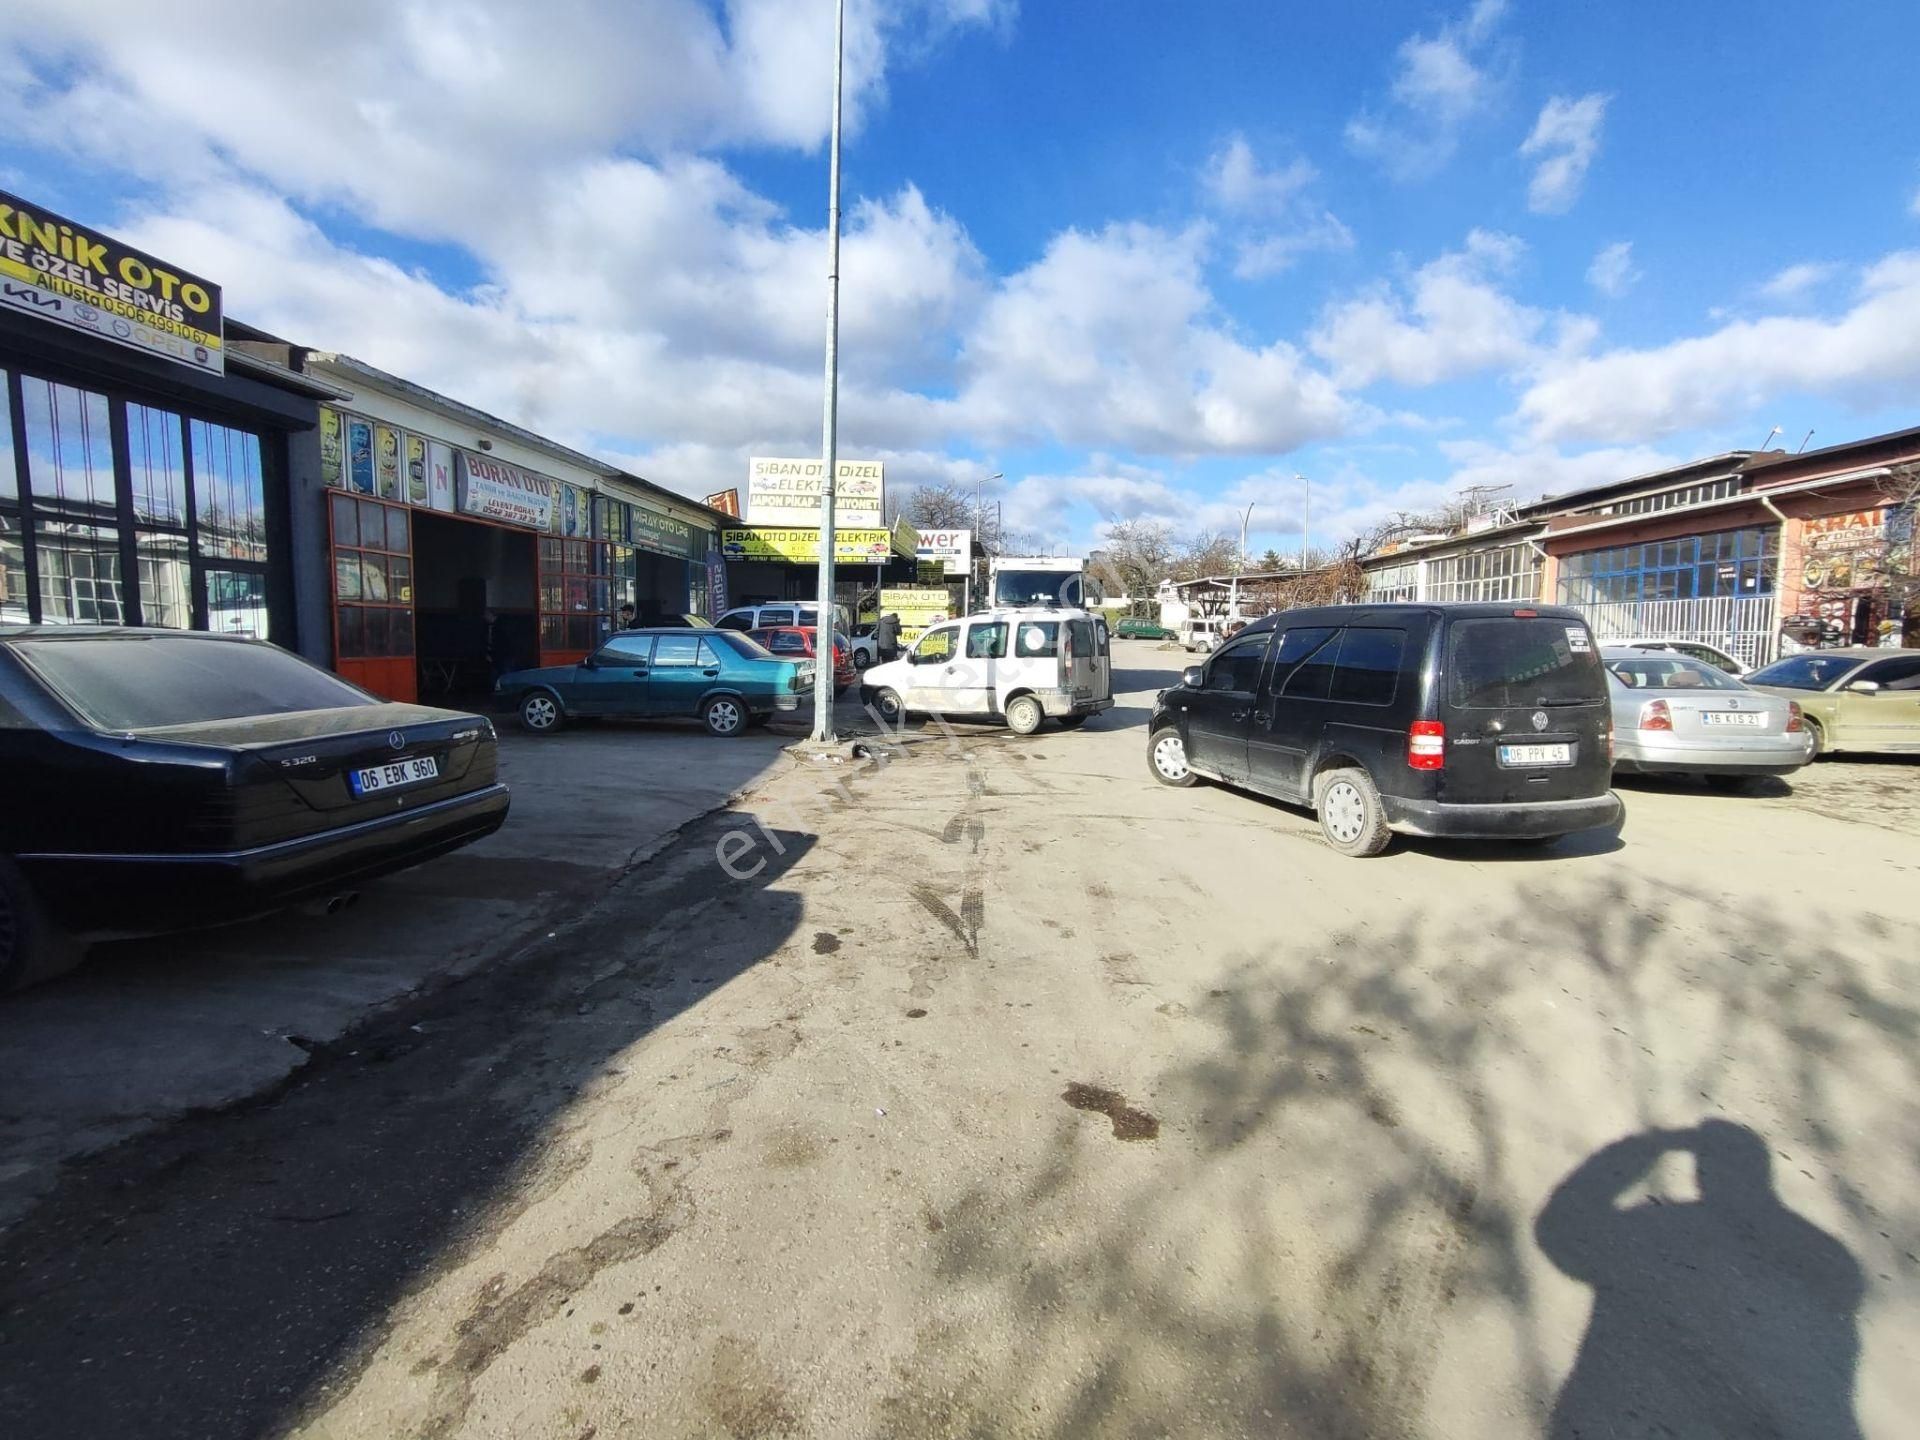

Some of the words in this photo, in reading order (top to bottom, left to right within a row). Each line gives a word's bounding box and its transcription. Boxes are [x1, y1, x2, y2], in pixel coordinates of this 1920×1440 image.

[32, 247, 100, 291] ÖZEL
[119, 256, 210, 313] OTO
[468, 457, 521, 490] BORAN
[522, 474, 550, 497] OTO
[751, 495, 784, 507] JAPON
[763, 532, 786, 542] OTO
[921, 593, 947, 601] OTO
[1510, 749, 1523, 760] 06
[1552, 748, 1564, 760] 45
[281, 760, 291, 768] S
[292, 755, 316, 766] 320
[361, 772, 379, 789] 06
[385, 765, 409, 785] EBK
[413, 758, 435, 778] 960
